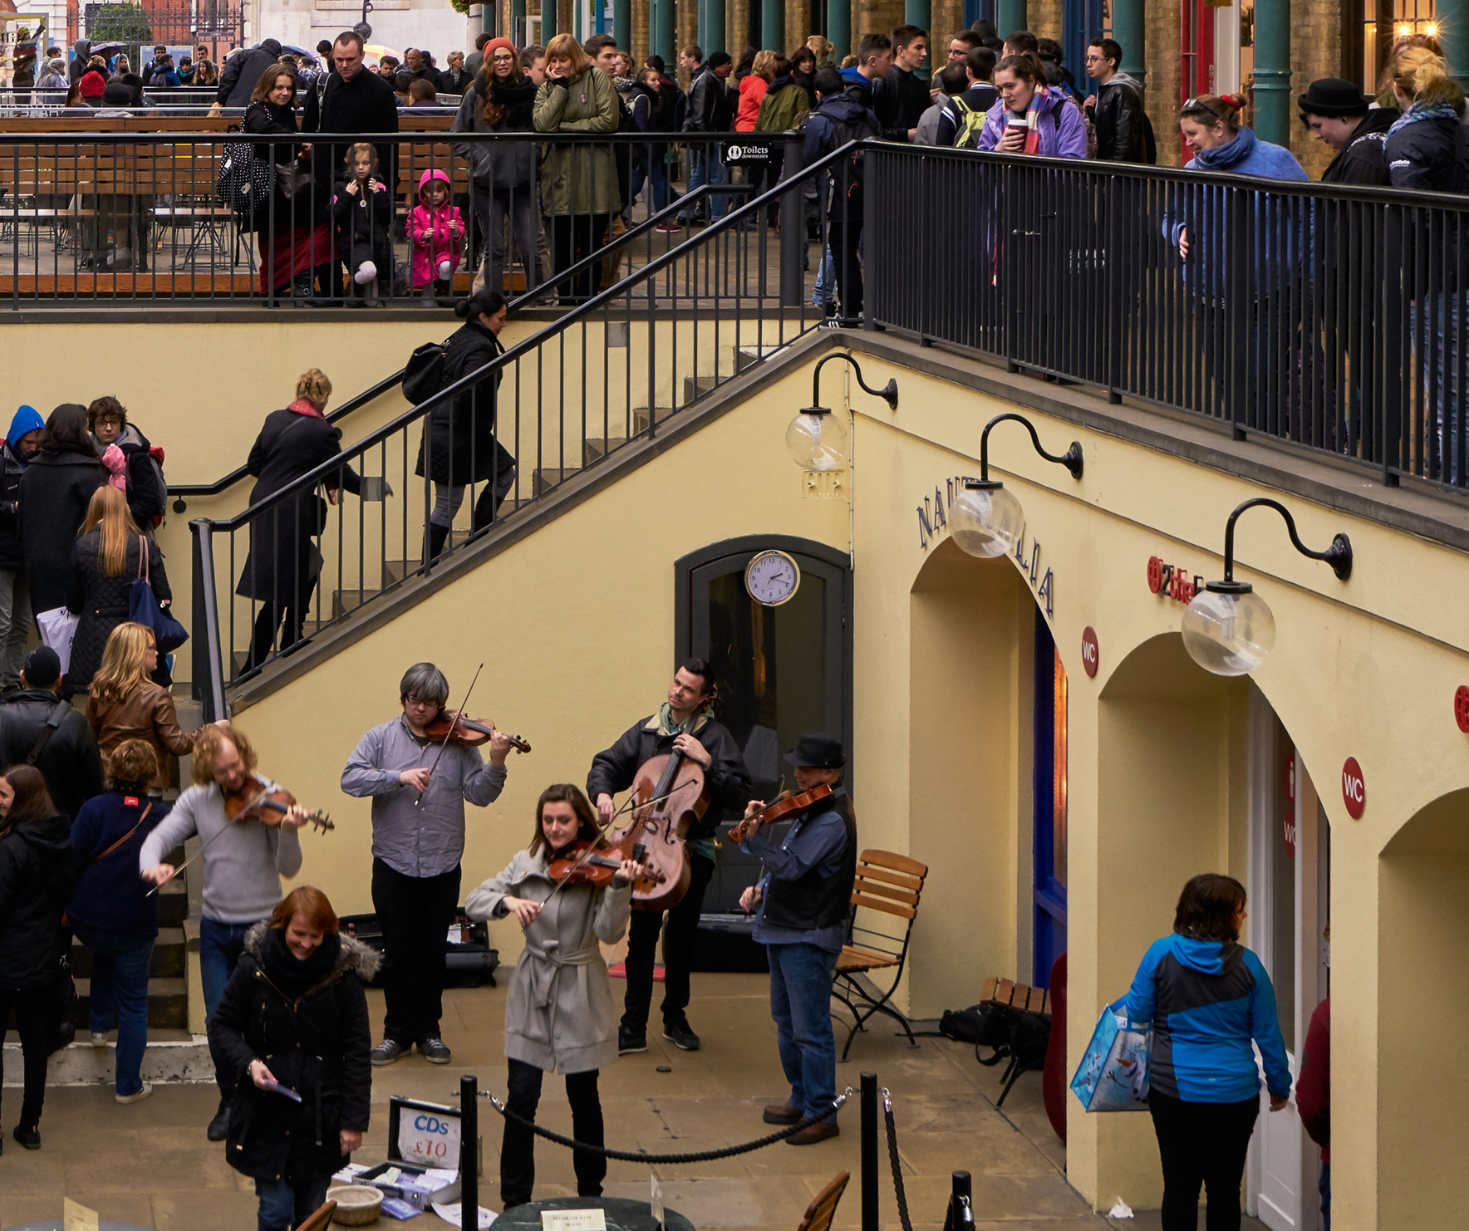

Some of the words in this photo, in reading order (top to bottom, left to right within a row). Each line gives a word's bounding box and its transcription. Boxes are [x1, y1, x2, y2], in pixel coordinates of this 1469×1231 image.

[741, 146, 769, 154] Toilets
[916, 476, 1054, 620] NAULIA
[1082, 640, 1096, 663] WC
[1343, 772, 1363, 803] WC
[414, 1115, 450, 1135] CDs
[413, 1140, 447, 1158] £10
